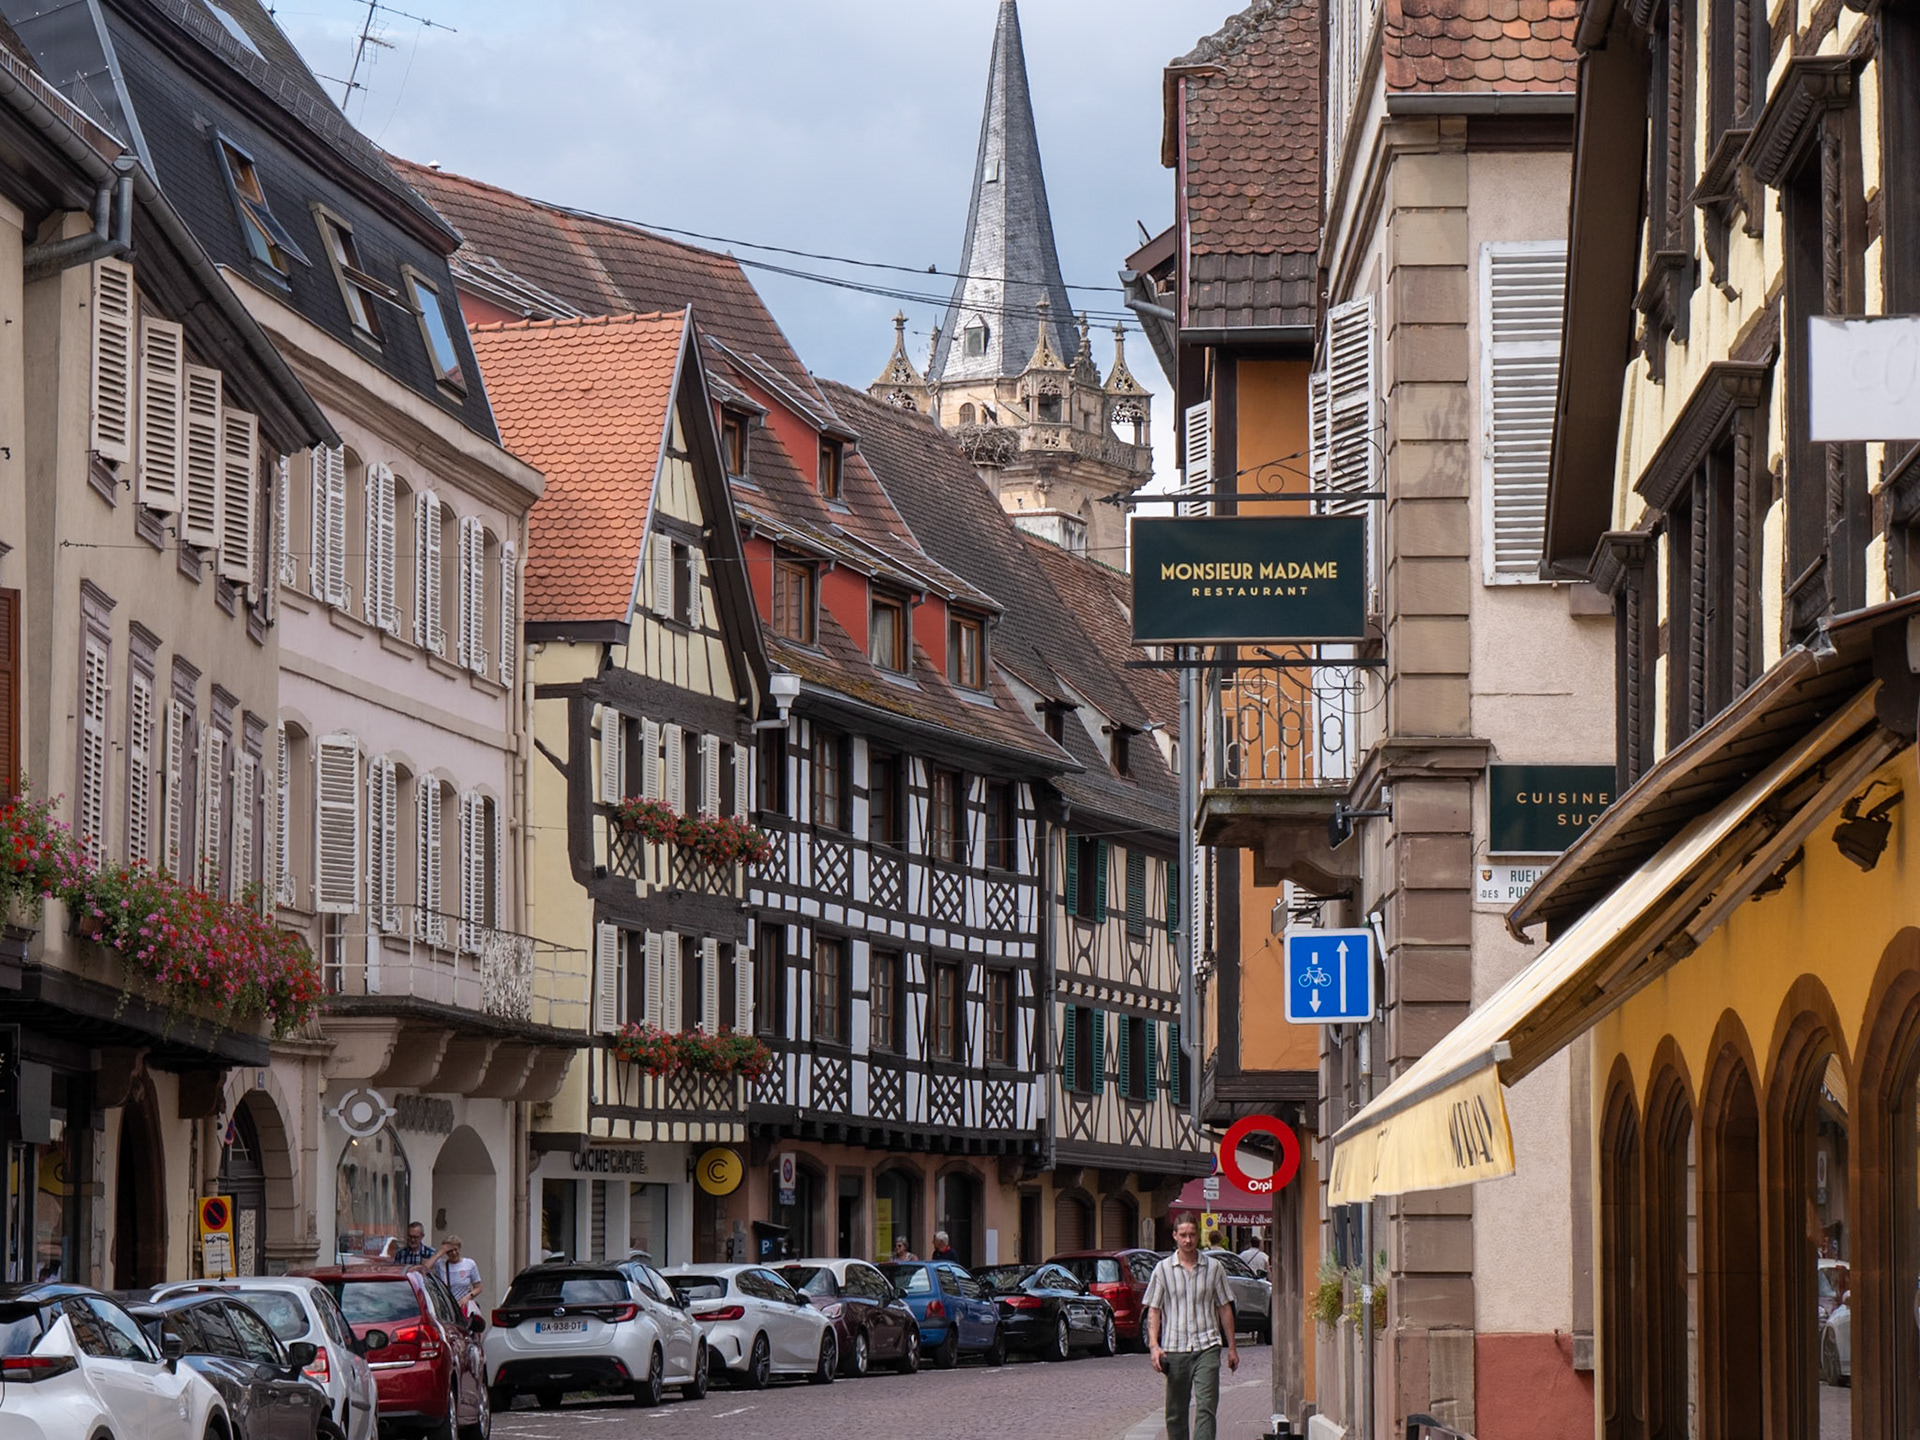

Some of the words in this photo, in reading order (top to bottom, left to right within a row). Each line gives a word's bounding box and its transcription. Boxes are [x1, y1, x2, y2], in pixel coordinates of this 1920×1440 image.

[1161, 562, 1253, 581] MONSIEUR
[1259, 561, 1338, 580] MADAME
[1192, 586, 1308, 597] RESTAURANT
[1516, 792, 1608, 805] CUISINE
[571, 1149, 609, 1172] CACHE
[1248, 1179, 1273, 1193] Orpi
